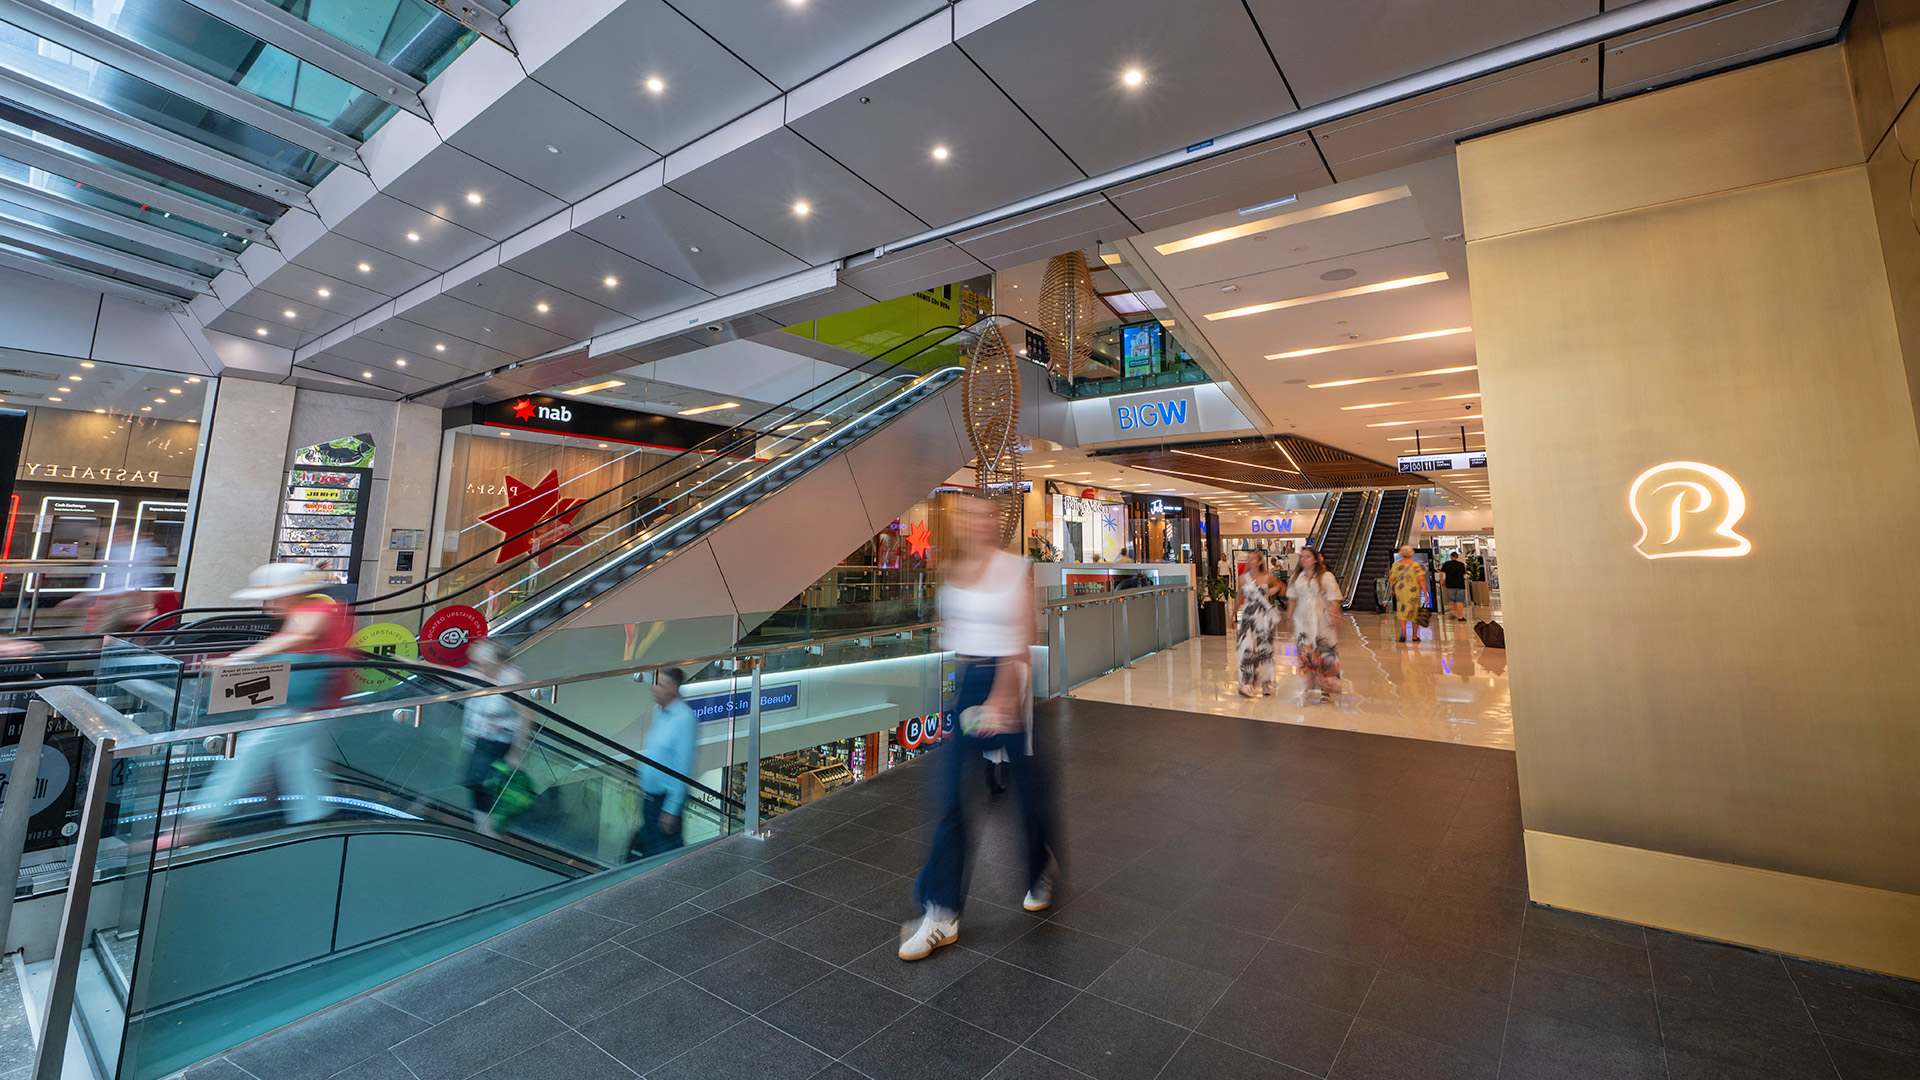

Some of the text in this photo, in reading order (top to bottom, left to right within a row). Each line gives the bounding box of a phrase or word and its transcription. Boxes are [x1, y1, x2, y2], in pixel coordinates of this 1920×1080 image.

[538, 405, 572, 422] nab
[319, 475, 348, 485] KFC
[446, 611, 475, 622] UPSTAIRS
[370, 629, 403, 641] UPSTAIRS
[760, 693, 793, 706] Beauty
